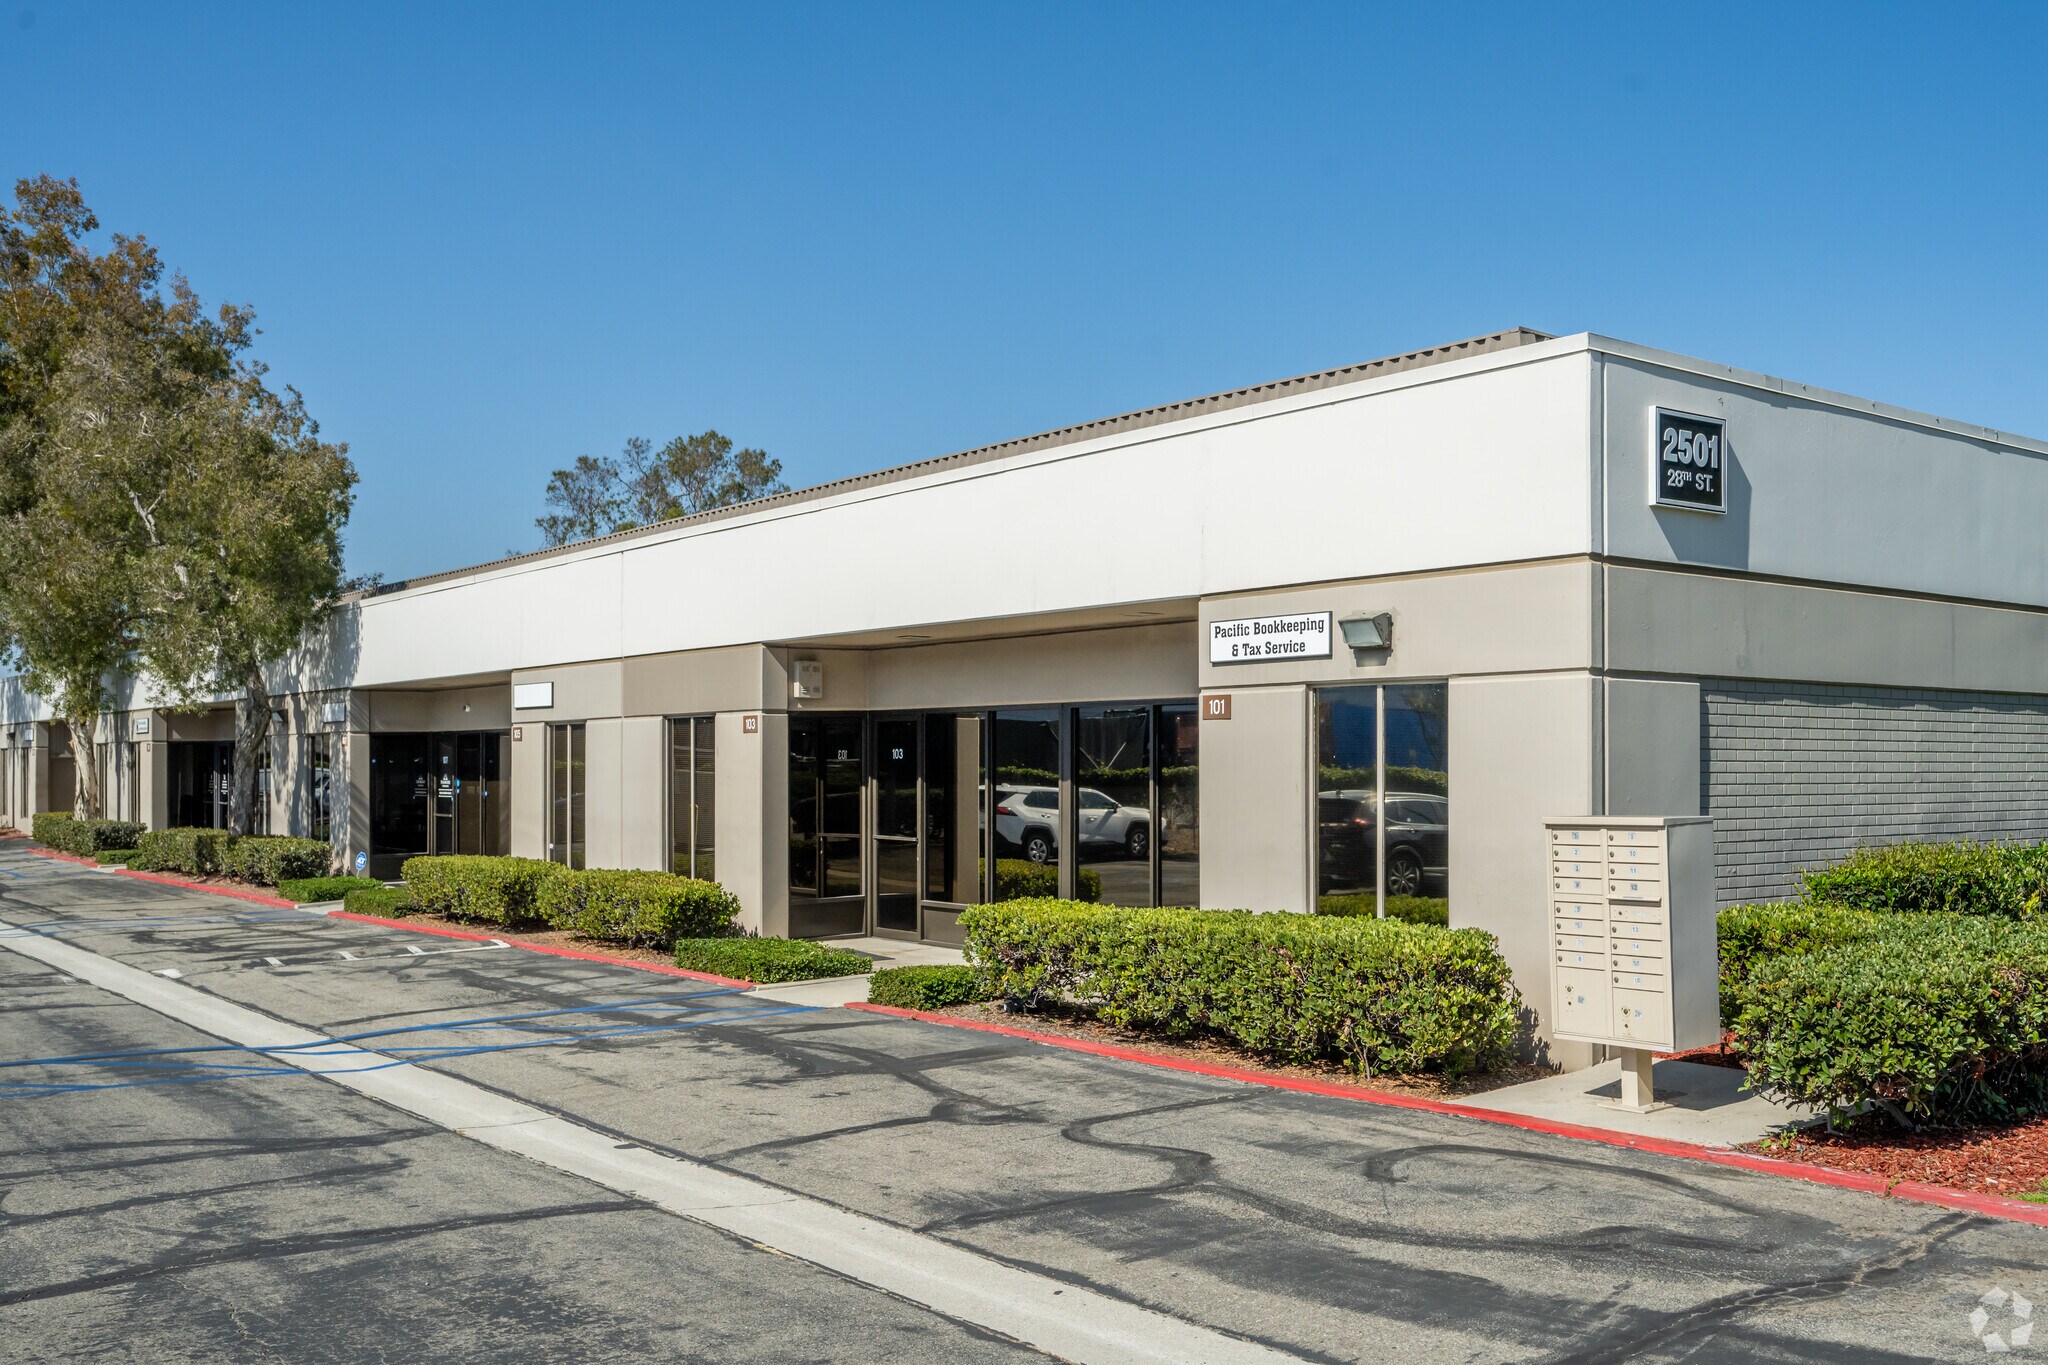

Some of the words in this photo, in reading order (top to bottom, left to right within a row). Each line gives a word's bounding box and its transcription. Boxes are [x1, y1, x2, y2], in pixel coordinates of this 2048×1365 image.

[1663, 427, 1718, 469] 2501
[1667, 469, 1692, 487] 28TH
[1695, 473, 1714, 492] ST.
[1214, 623, 1250, 639] Pacific
[1253, 617, 1325, 635] Bookkeeping
[1231, 643, 1239, 657] &
[1242, 643, 1262, 656] Tax
[1265, 640, 1306, 655] Service
[1208, 699, 1225, 715] 101
[745, 718, 756, 730] 103
[892, 748, 904, 760] 103
